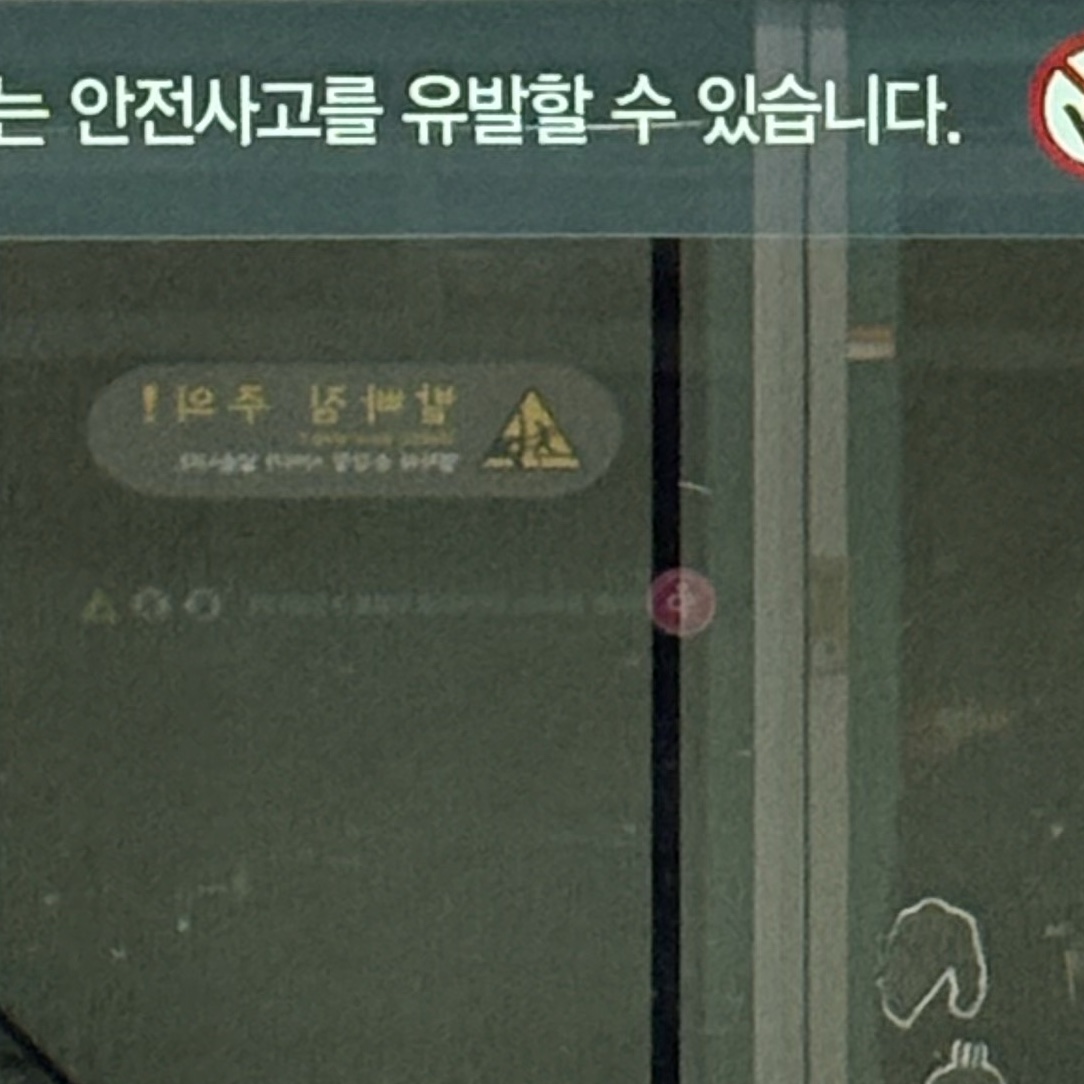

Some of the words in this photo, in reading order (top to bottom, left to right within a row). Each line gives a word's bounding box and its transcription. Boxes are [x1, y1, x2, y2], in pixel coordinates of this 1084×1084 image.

[0, 75, 50, 146] 는
[70, 74, 384, 147] 안전사고를
[402, 73, 595, 146] 유발할
[610, 73, 677, 146] 수
[697, 73, 961, 146] 있습니다.
